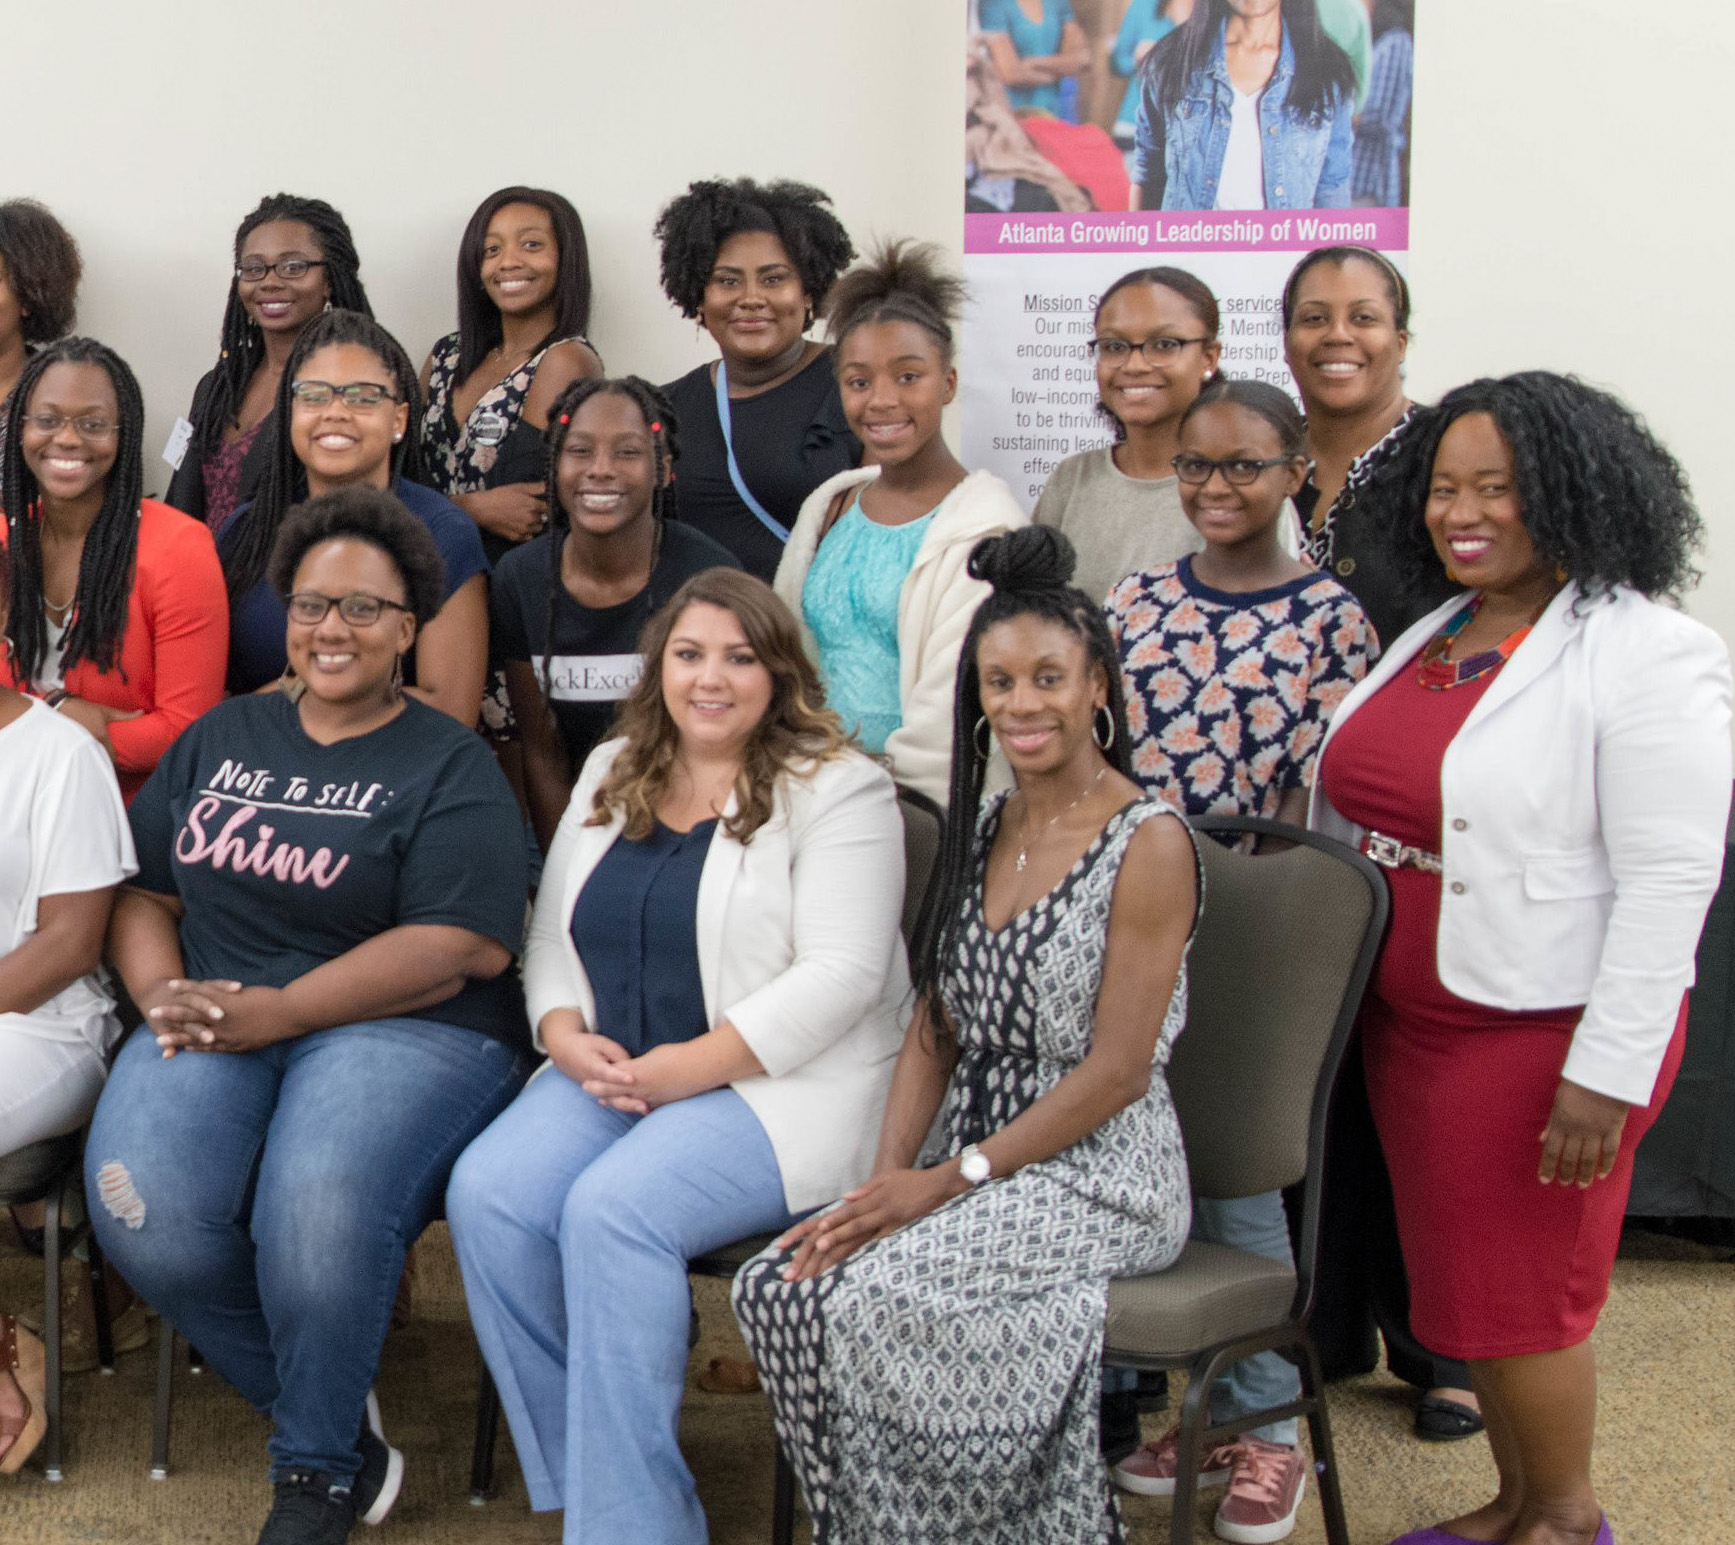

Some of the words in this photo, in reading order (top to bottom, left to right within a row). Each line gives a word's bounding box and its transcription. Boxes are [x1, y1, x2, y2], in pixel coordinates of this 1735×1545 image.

[998, 222, 1065, 244] Atlanta
[1070, 221, 1148, 246] Growing
[1156, 219, 1264, 244] Leadership
[1270, 219, 1291, 241] of
[1296, 219, 1377, 241] Women
[1024, 294, 1082, 311] Mission
[1227, 295, 1283, 311] service
[1035, 317, 1062, 334] Our
[1220, 343, 1278, 362] dership
[1032, 365, 1060, 381] and
[1255, 367, 1291, 386] Prep
[1016, 411, 1031, 427] to
[1036, 411, 1053, 428] be
[992, 434, 1069, 454] sustaining
[176, 796, 350, 889] Shine
